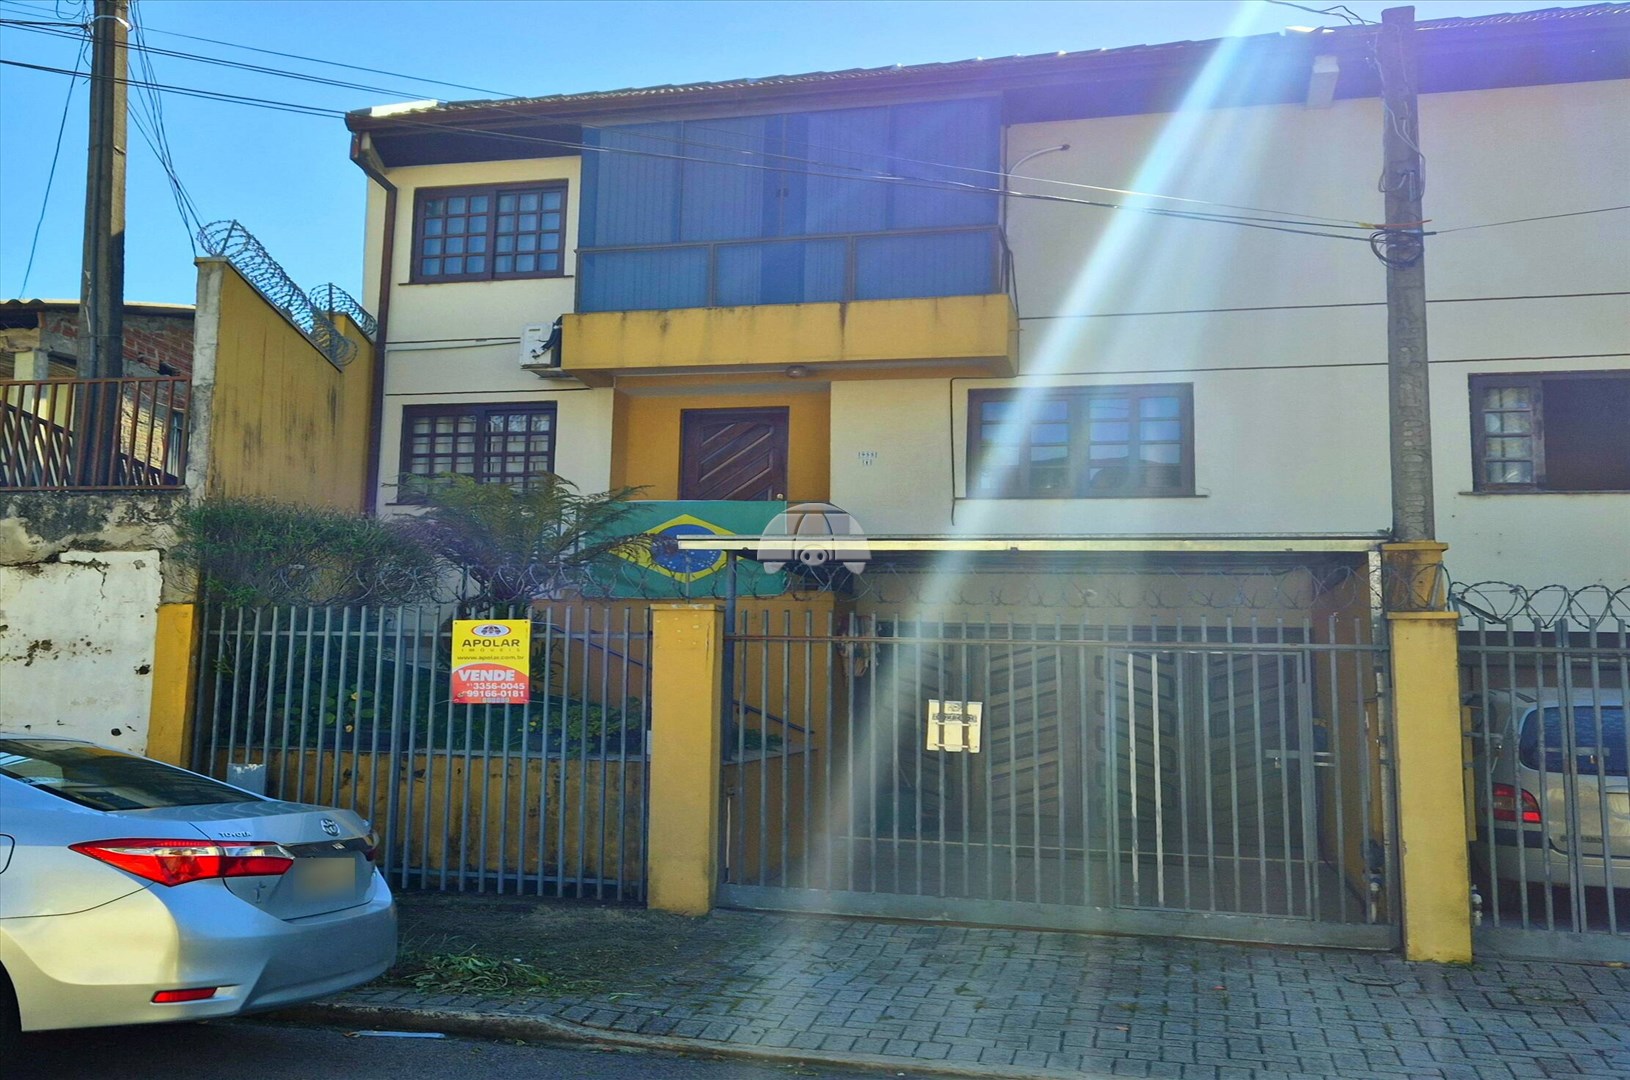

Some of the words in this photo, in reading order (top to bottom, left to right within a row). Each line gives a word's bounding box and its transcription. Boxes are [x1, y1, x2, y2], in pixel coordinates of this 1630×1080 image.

[462, 639, 520, 647] APOLAR
[458, 669, 515, 682] VENDE
[473, 682, 525, 690] 3356-0045
